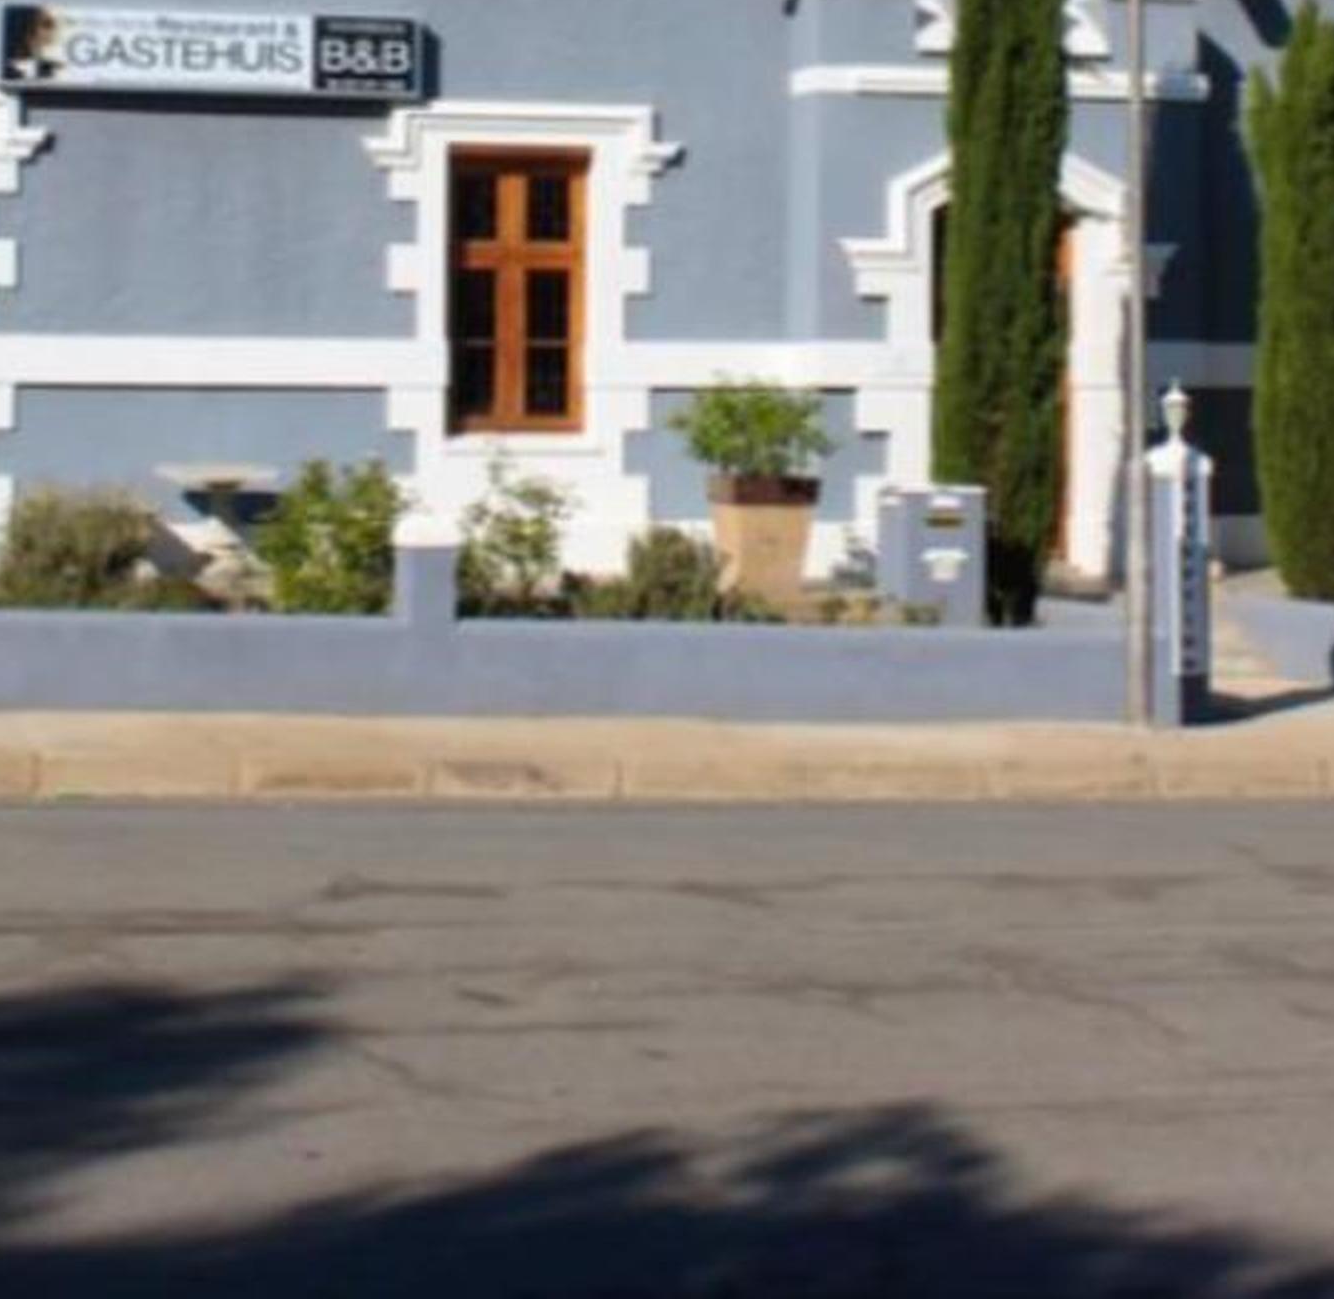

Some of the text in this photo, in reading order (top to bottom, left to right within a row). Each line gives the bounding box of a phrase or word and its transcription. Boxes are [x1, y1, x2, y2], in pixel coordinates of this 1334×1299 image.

[155, 15, 277, 36] Restaurant
[66, 32, 304, 74] GASTEHUIS
[320, 38, 409, 74] B&B
